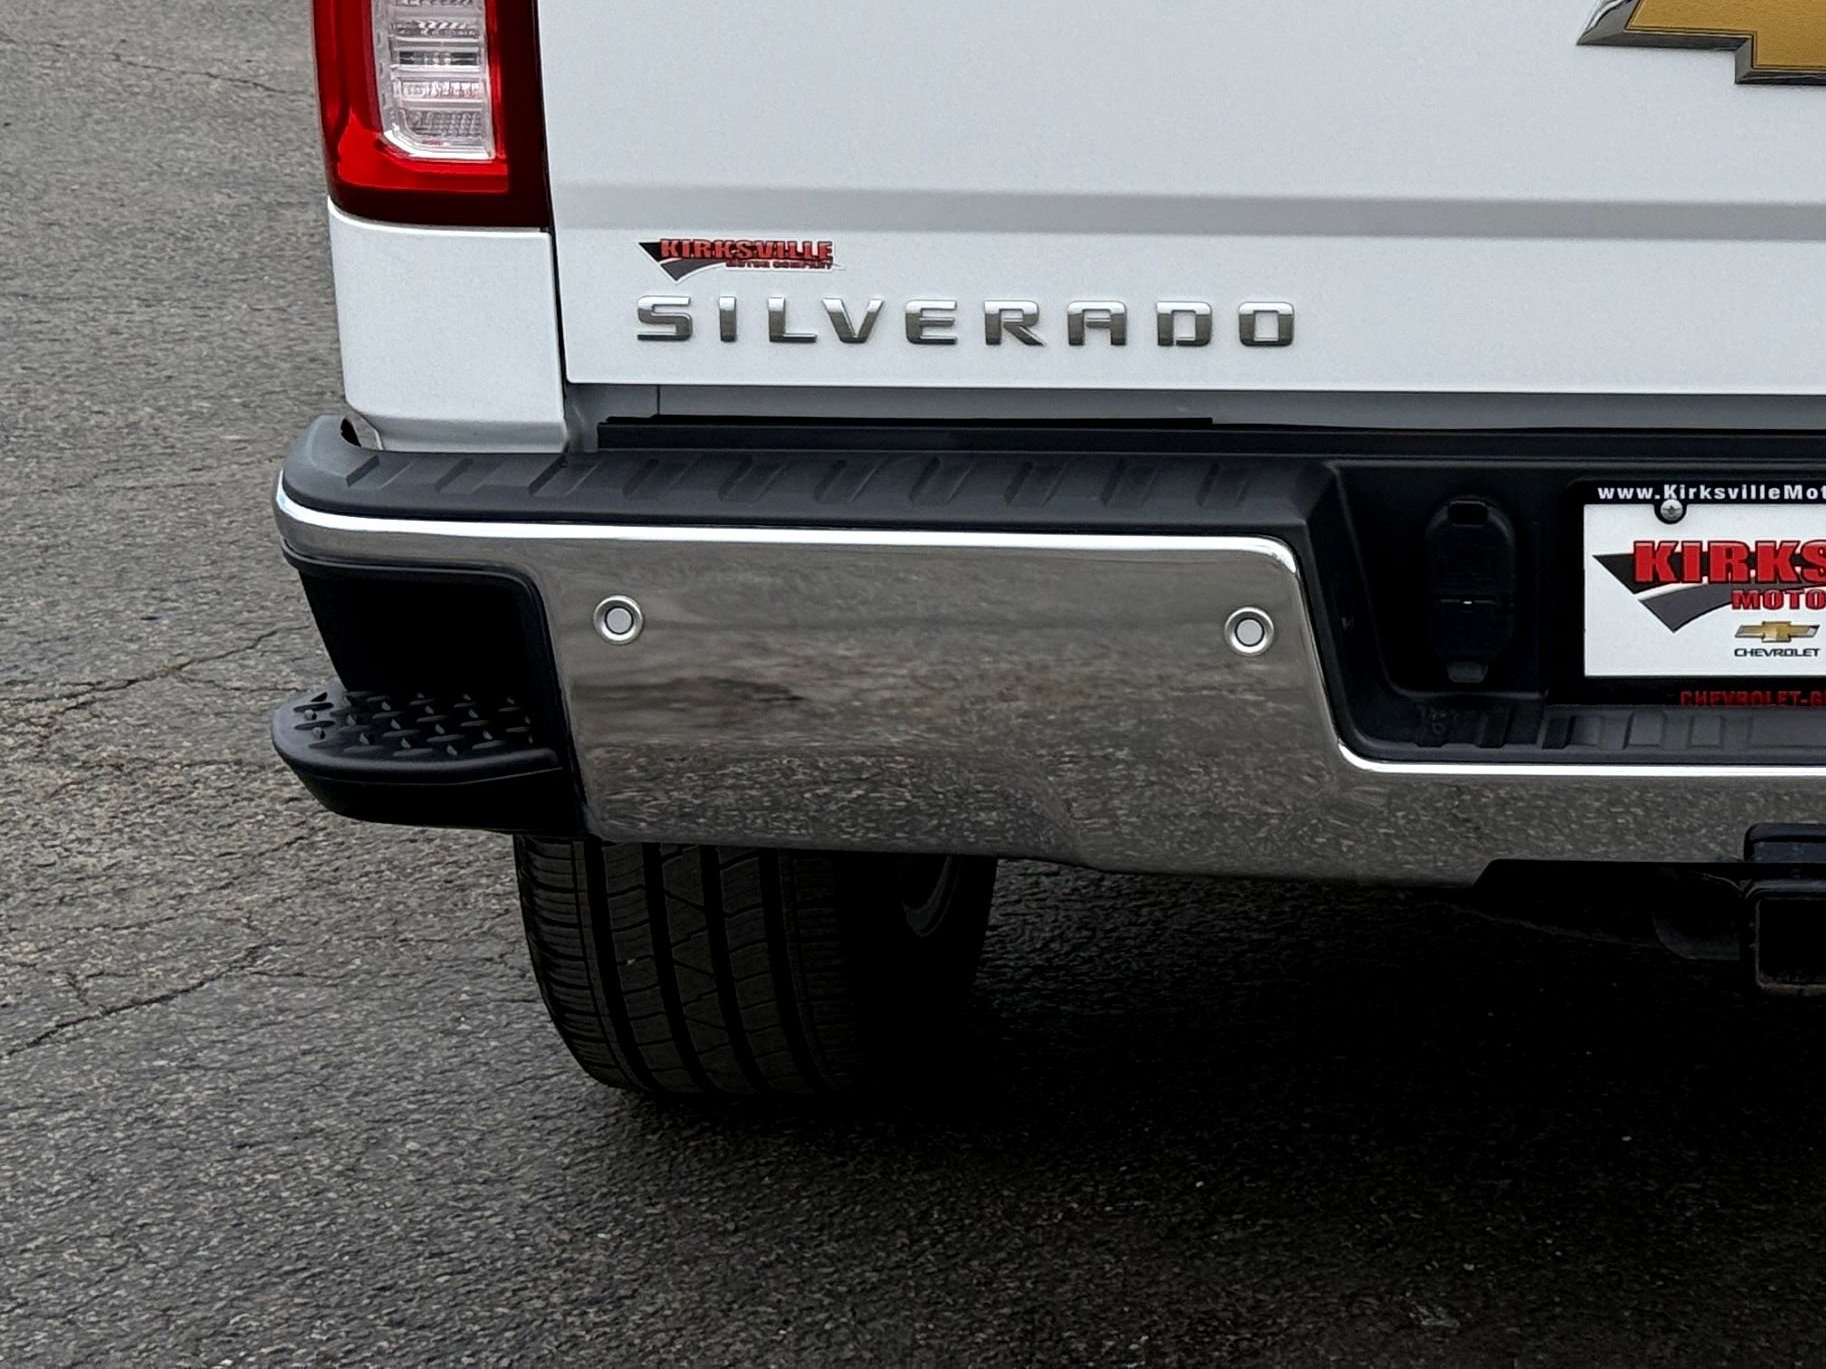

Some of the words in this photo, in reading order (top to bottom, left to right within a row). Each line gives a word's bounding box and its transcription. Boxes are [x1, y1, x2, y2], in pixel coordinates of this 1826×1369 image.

[660, 239, 833, 259] KIRKSVILLE
[636, 295, 1296, 347] SILVERADO
[1734, 648, 1821, 658] CHEVROLET
